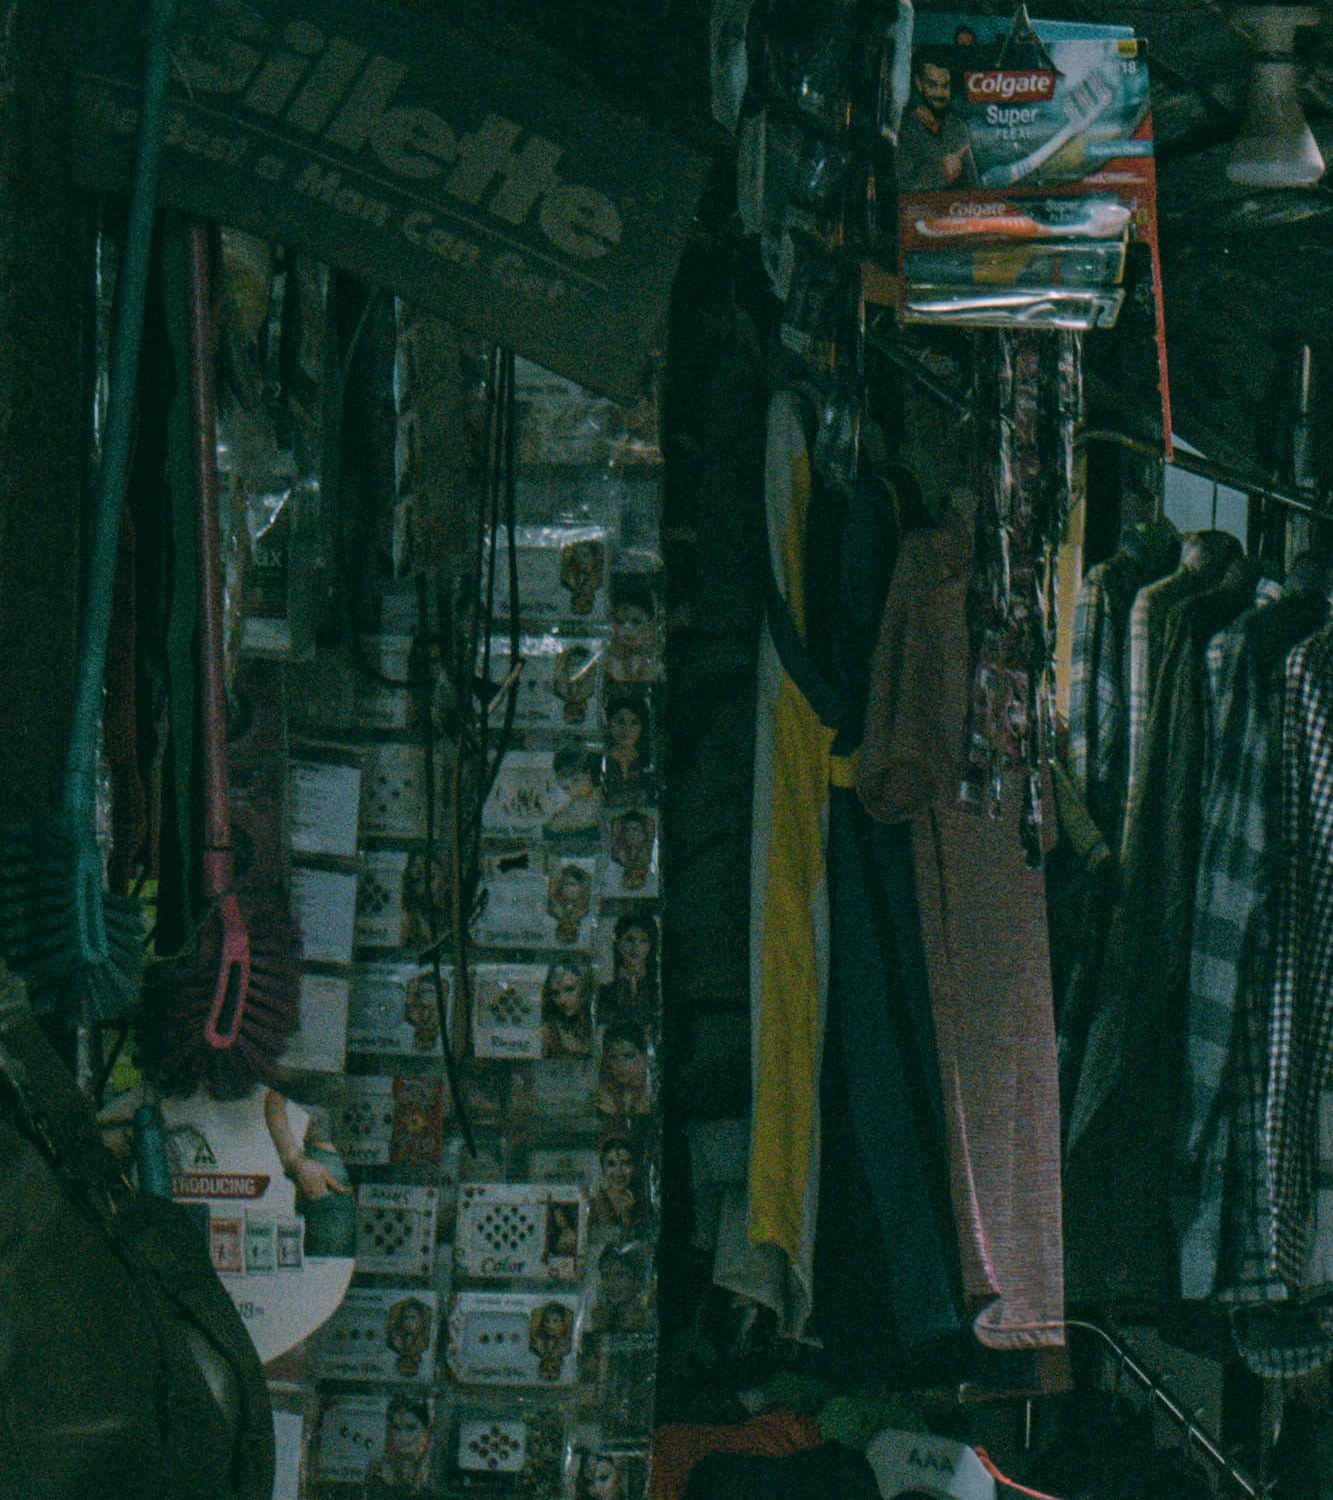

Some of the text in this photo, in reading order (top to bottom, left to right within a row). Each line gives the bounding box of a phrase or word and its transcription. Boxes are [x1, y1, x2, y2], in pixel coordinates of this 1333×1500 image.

[968, 73, 1051, 98] Colgate
[987, 105, 1039, 128] Super
[948, 202, 1008, 219] Colgate
